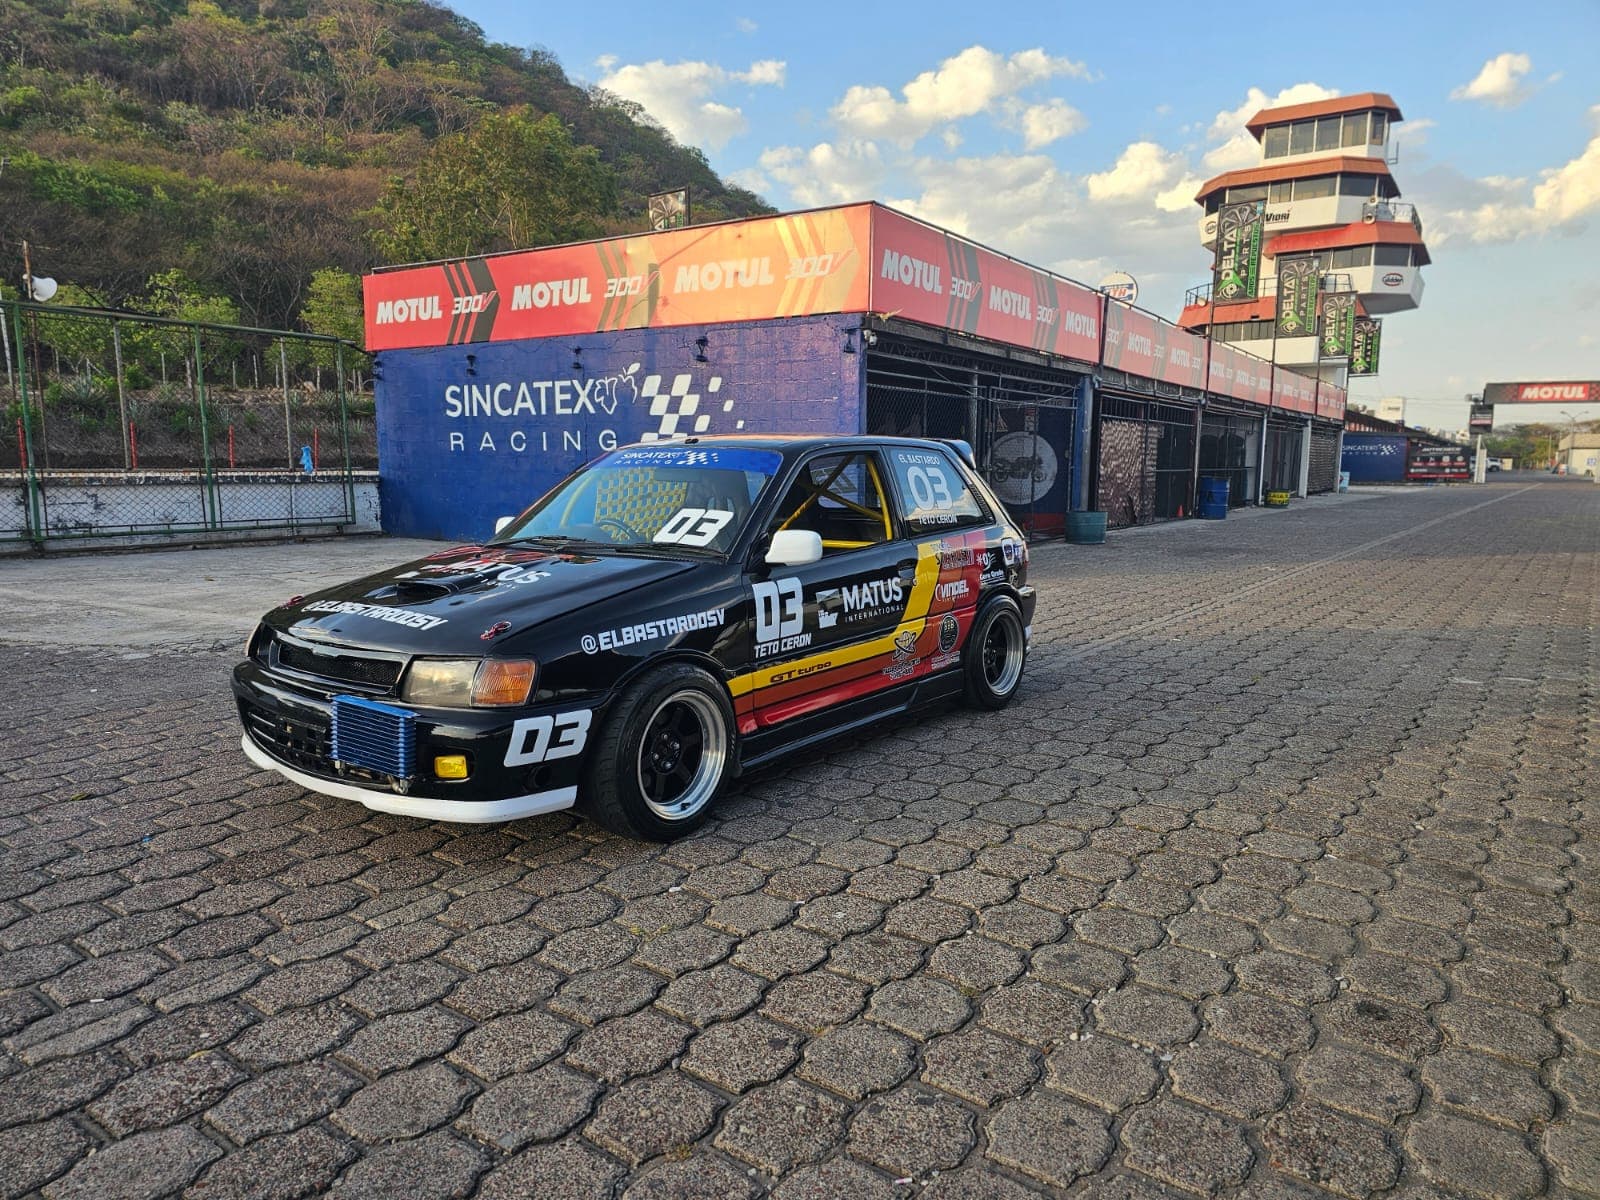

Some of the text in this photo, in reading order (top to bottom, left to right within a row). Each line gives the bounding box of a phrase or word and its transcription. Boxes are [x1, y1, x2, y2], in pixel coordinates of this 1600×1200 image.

[1221, 228, 1237, 280] DELTA
[1241, 225, 1251, 277] PARTS
[376, 296, 443, 325] MOTUL
[452, 291, 499, 315] 300V
[511, 277, 592, 311] MOTUL
[673, 256, 775, 294] MOTUL
[881, 249, 942, 294] MOTUL
[989, 285, 1032, 321] MOTUL
[1065, 310, 1097, 340] MOTUL
[1127, 331, 1152, 357] MOTUL
[445, 378, 597, 418] SINCATEX
[1521, 385, 1586, 400] MOTUL
[450, 429, 617, 451] RACING
[907, 466, 953, 511] 03
[652, 508, 734, 547] 03
[752, 577, 803, 643] 03
[842, 577, 903, 613] MATUS
[845, 606, 904, 623] INTERNATIONAL
[754, 632, 812, 659] TETO CERON
[770, 661, 832, 683] GT turbo
[503, 709, 593, 768] 03
